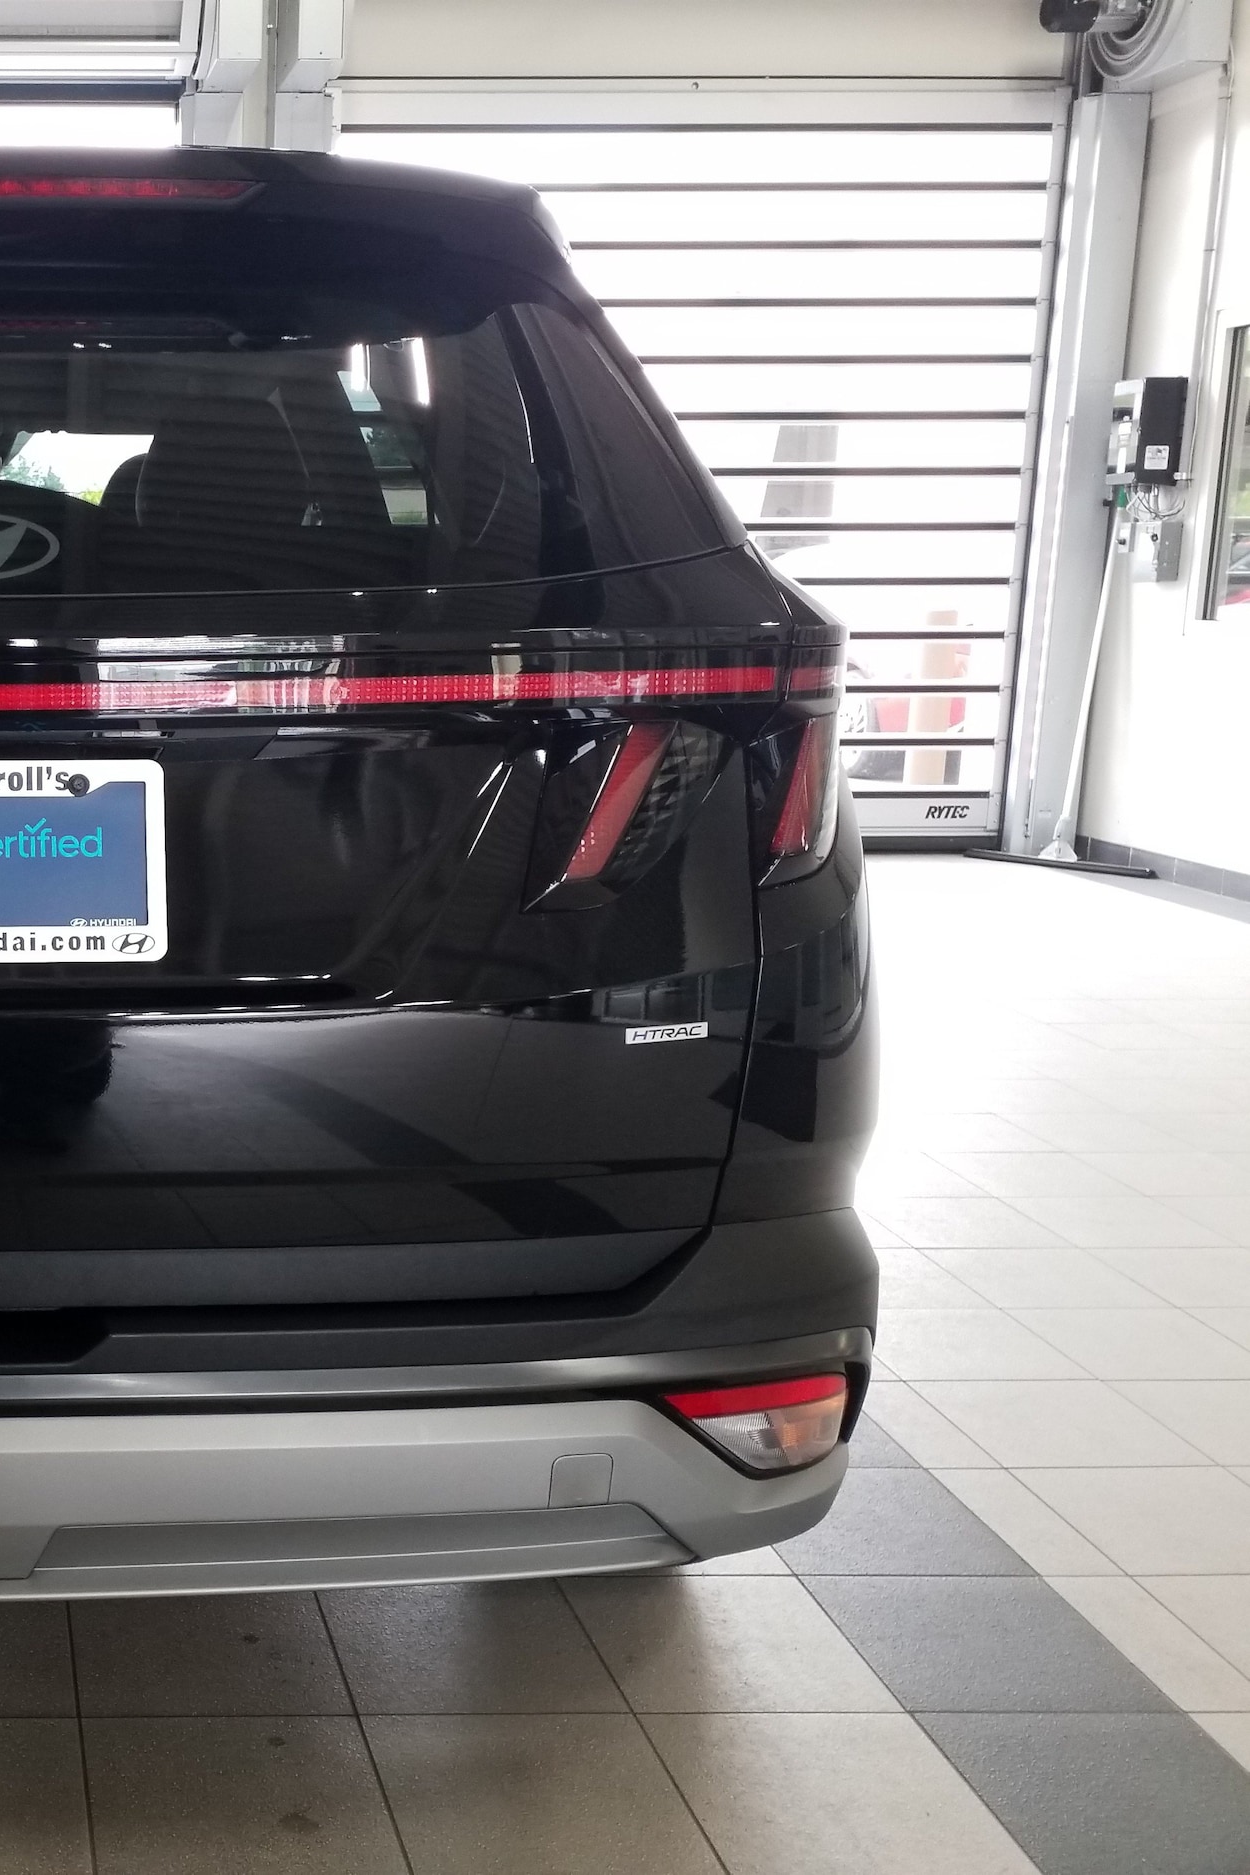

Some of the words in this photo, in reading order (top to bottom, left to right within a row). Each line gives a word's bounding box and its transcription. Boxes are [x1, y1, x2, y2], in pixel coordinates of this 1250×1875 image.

[925, 805, 970, 819] RYTEC
[89, 918, 137, 927] HYUNDAI
[632, 1025, 703, 1041] HTRAC
